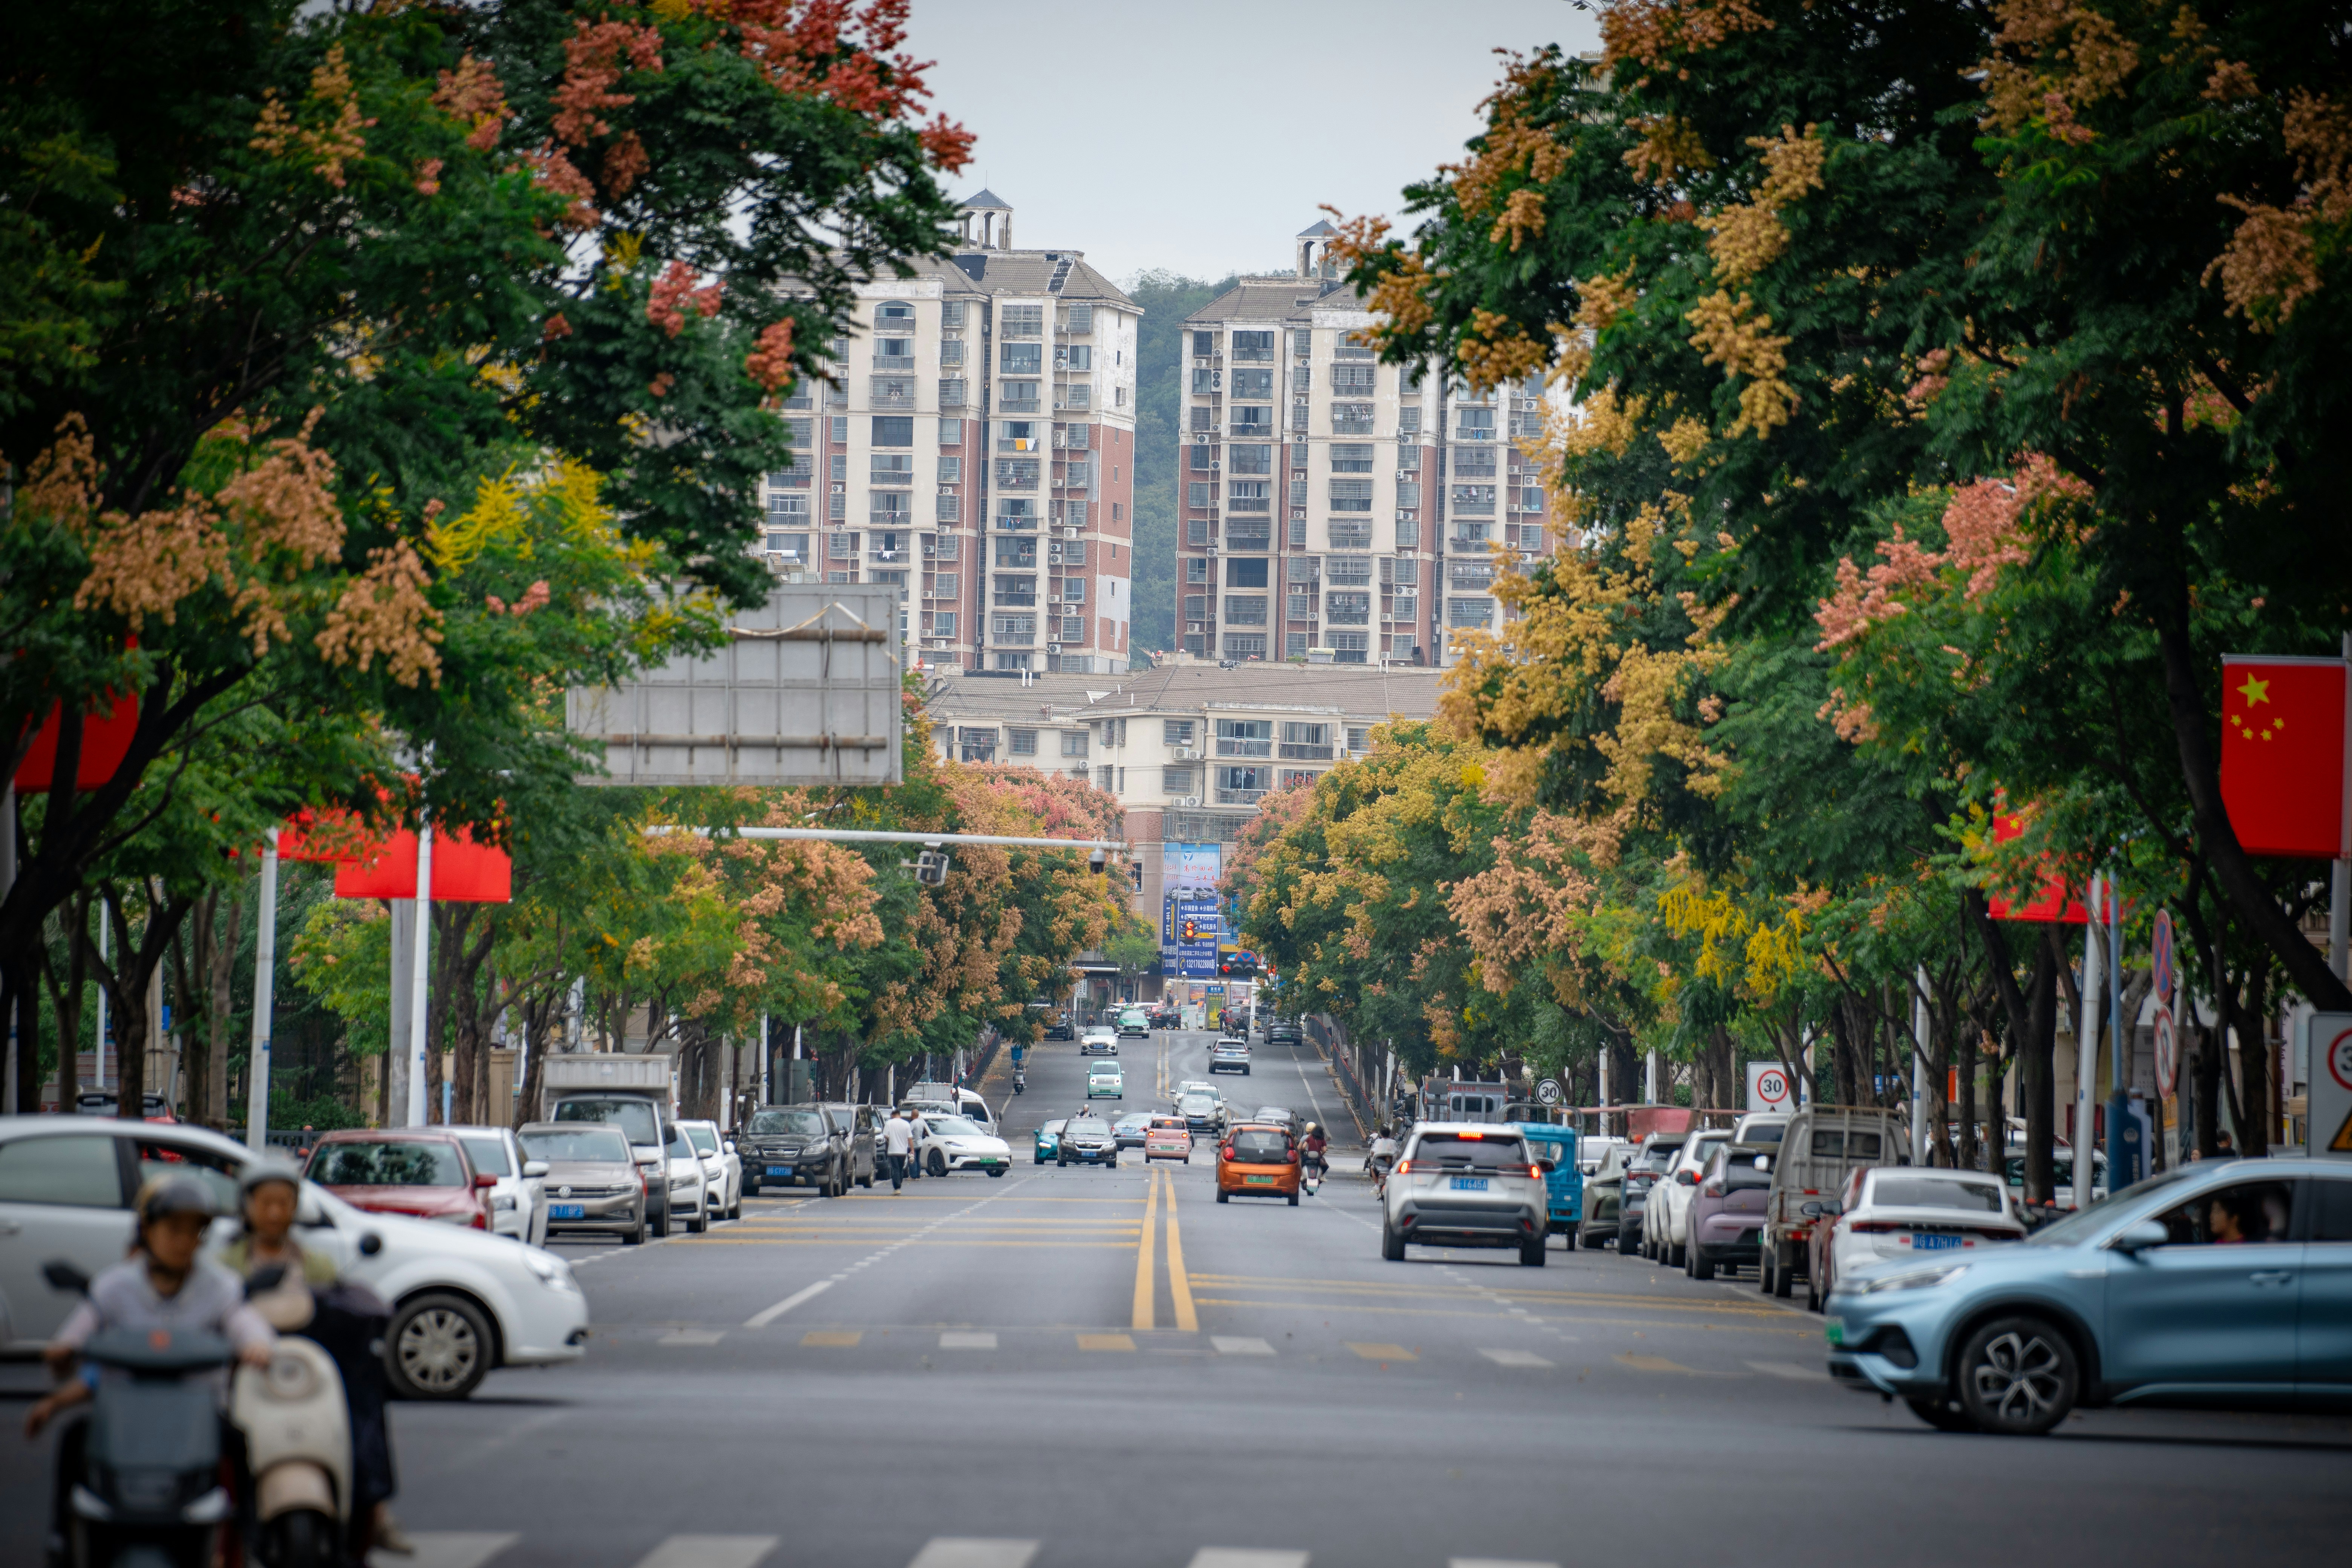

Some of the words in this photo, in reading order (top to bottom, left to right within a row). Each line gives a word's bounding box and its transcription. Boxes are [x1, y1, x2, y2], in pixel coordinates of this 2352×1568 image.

[1184, 864, 1214, 873] 高价回收
[1764, 1079, 1781, 1092] 30
[1541, 1086, 1557, 1098] 30
[550, 1206, 583, 1214] G718P3
